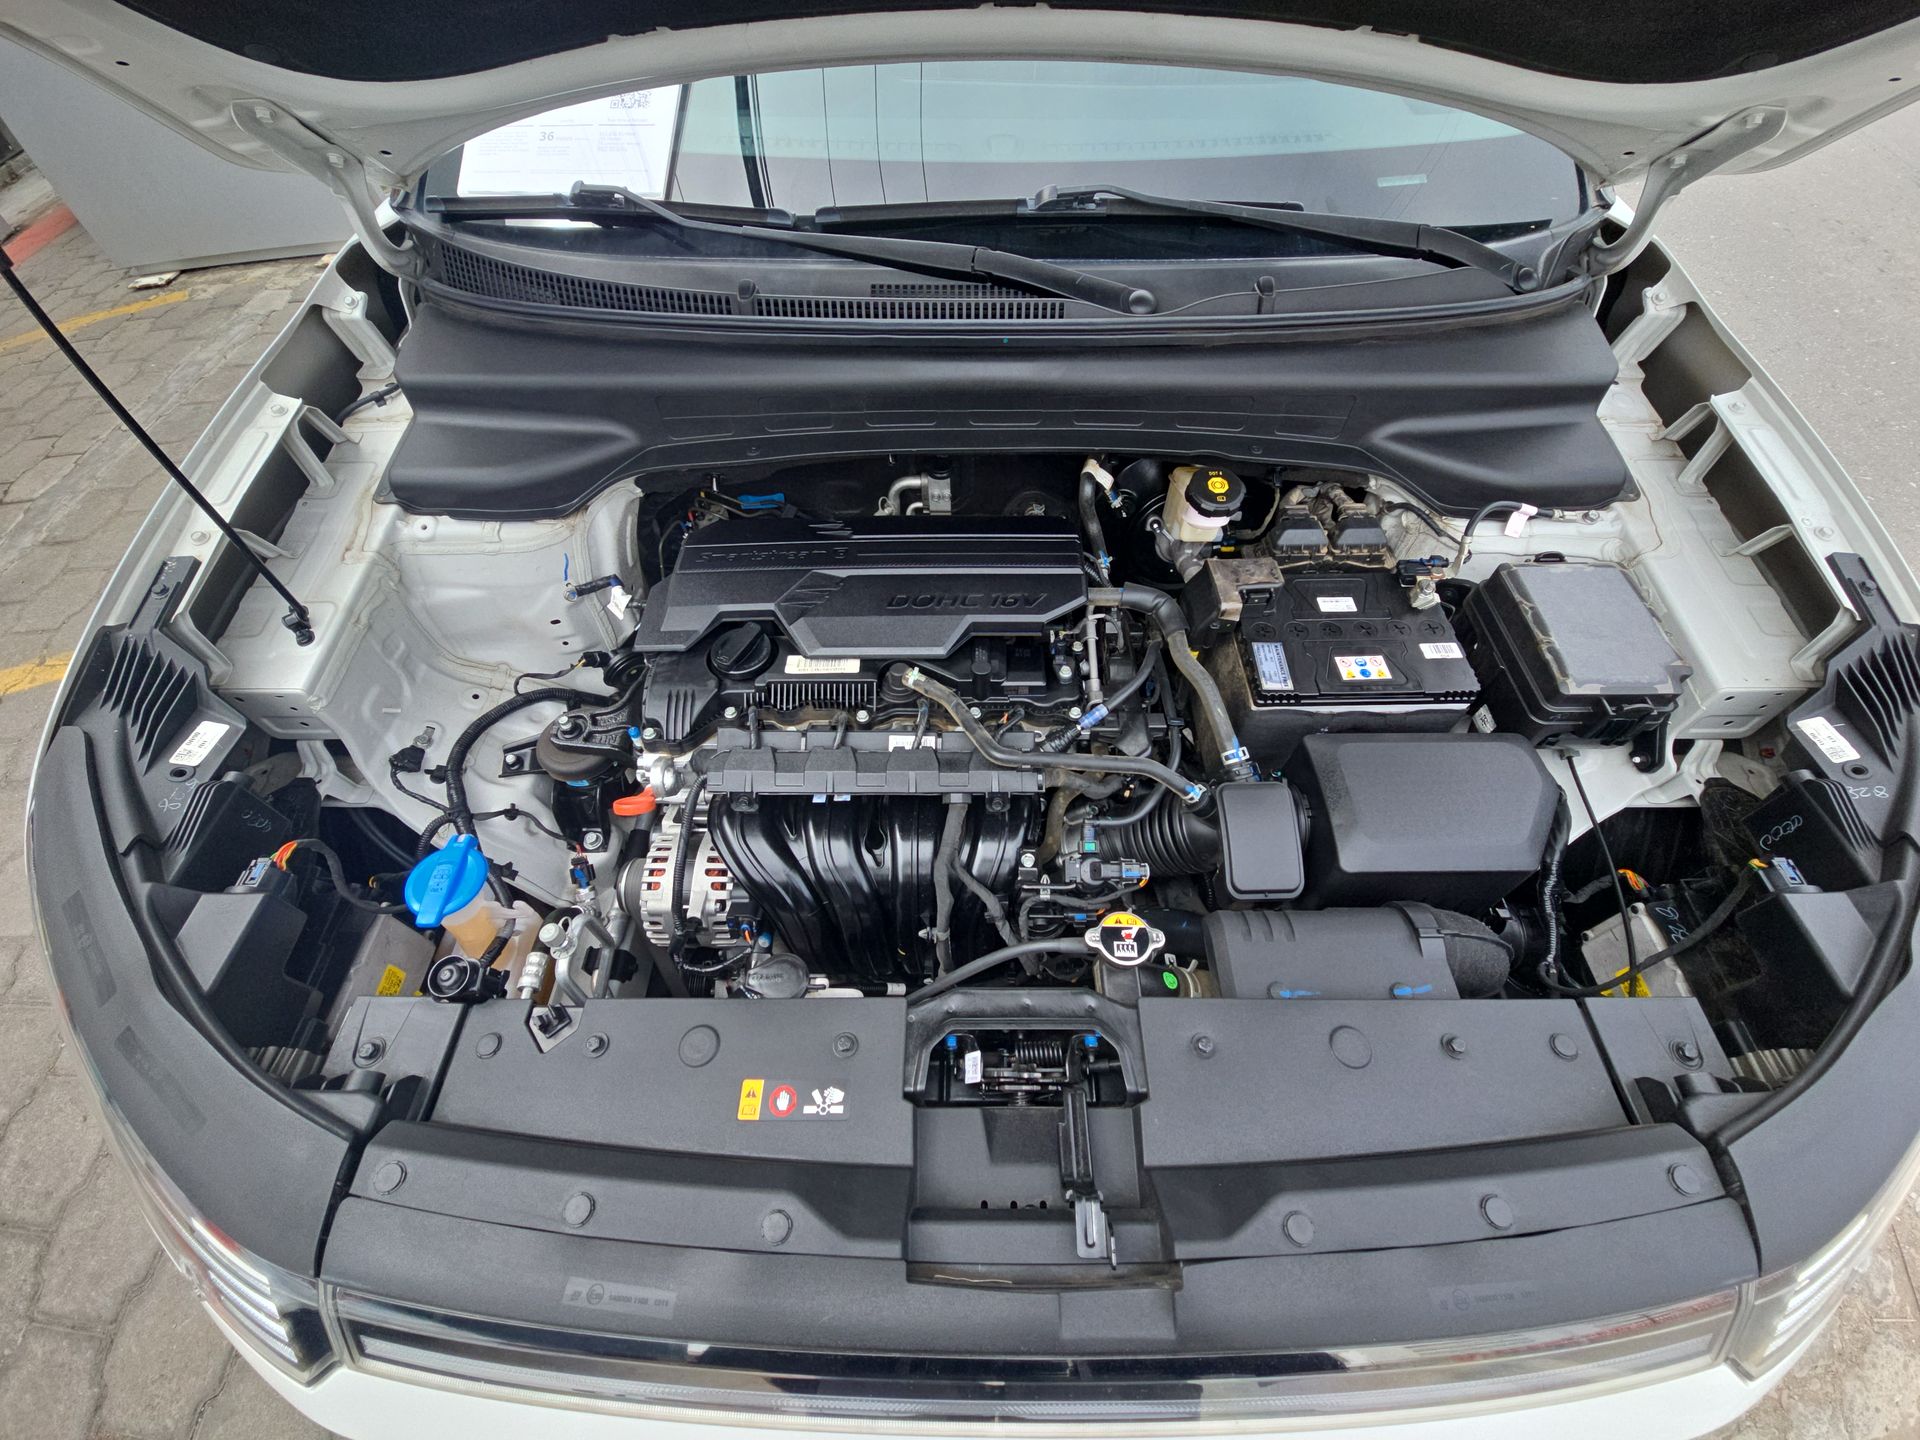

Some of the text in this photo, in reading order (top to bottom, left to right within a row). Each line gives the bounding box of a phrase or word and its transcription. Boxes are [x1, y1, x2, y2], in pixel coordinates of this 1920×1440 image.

[539, 131, 555, 142] 36
[885, 593, 1048, 609] DOHC 16V
